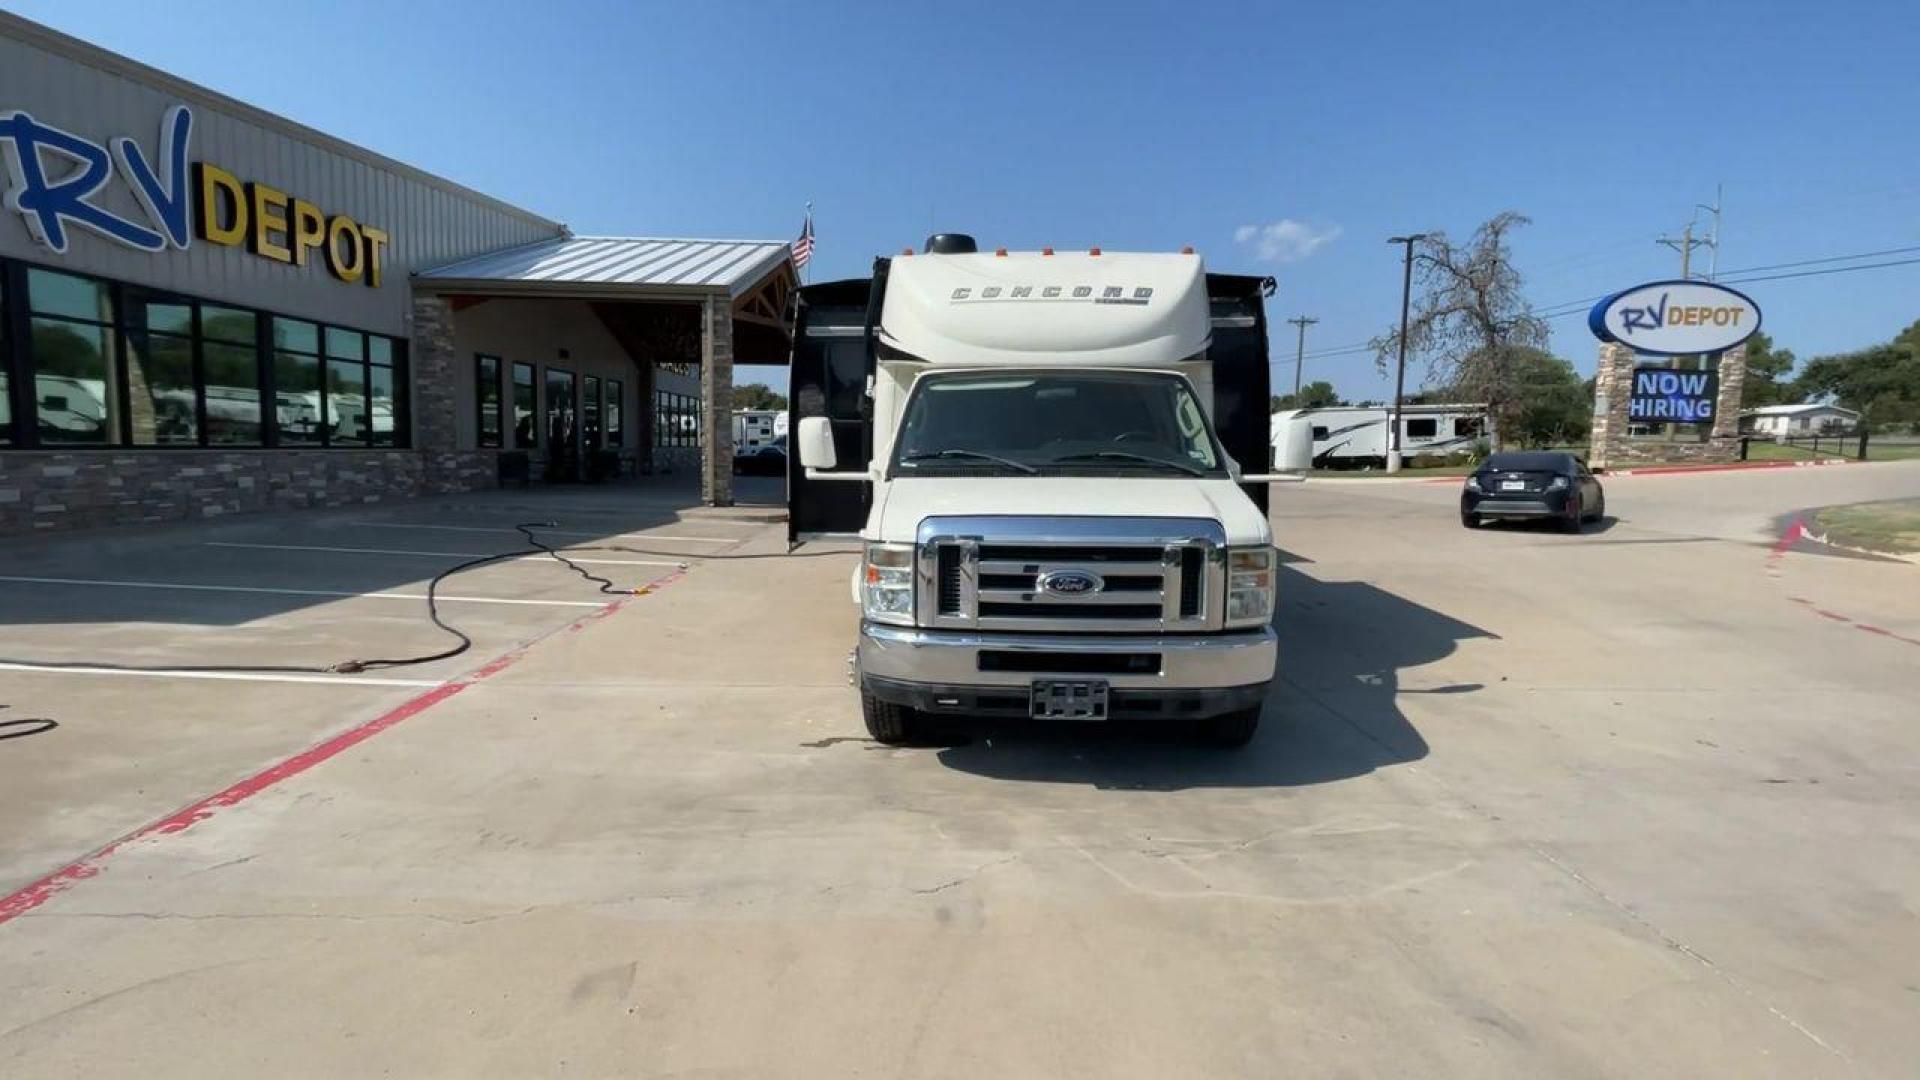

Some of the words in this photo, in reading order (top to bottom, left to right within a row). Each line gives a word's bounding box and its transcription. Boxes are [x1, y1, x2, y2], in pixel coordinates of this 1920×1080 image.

[0, 105, 192, 252] RV
[195, 161, 388, 288] DEPOT
[951, 286, 1153, 299] CONCORD
[1620, 293, 1668, 335] RV
[1669, 307, 1744, 326] DEPOT
[1637, 373, 1708, 395] NOW
[1630, 399, 1712, 417] HIRING
[1055, 577, 1088, 591] Ford
